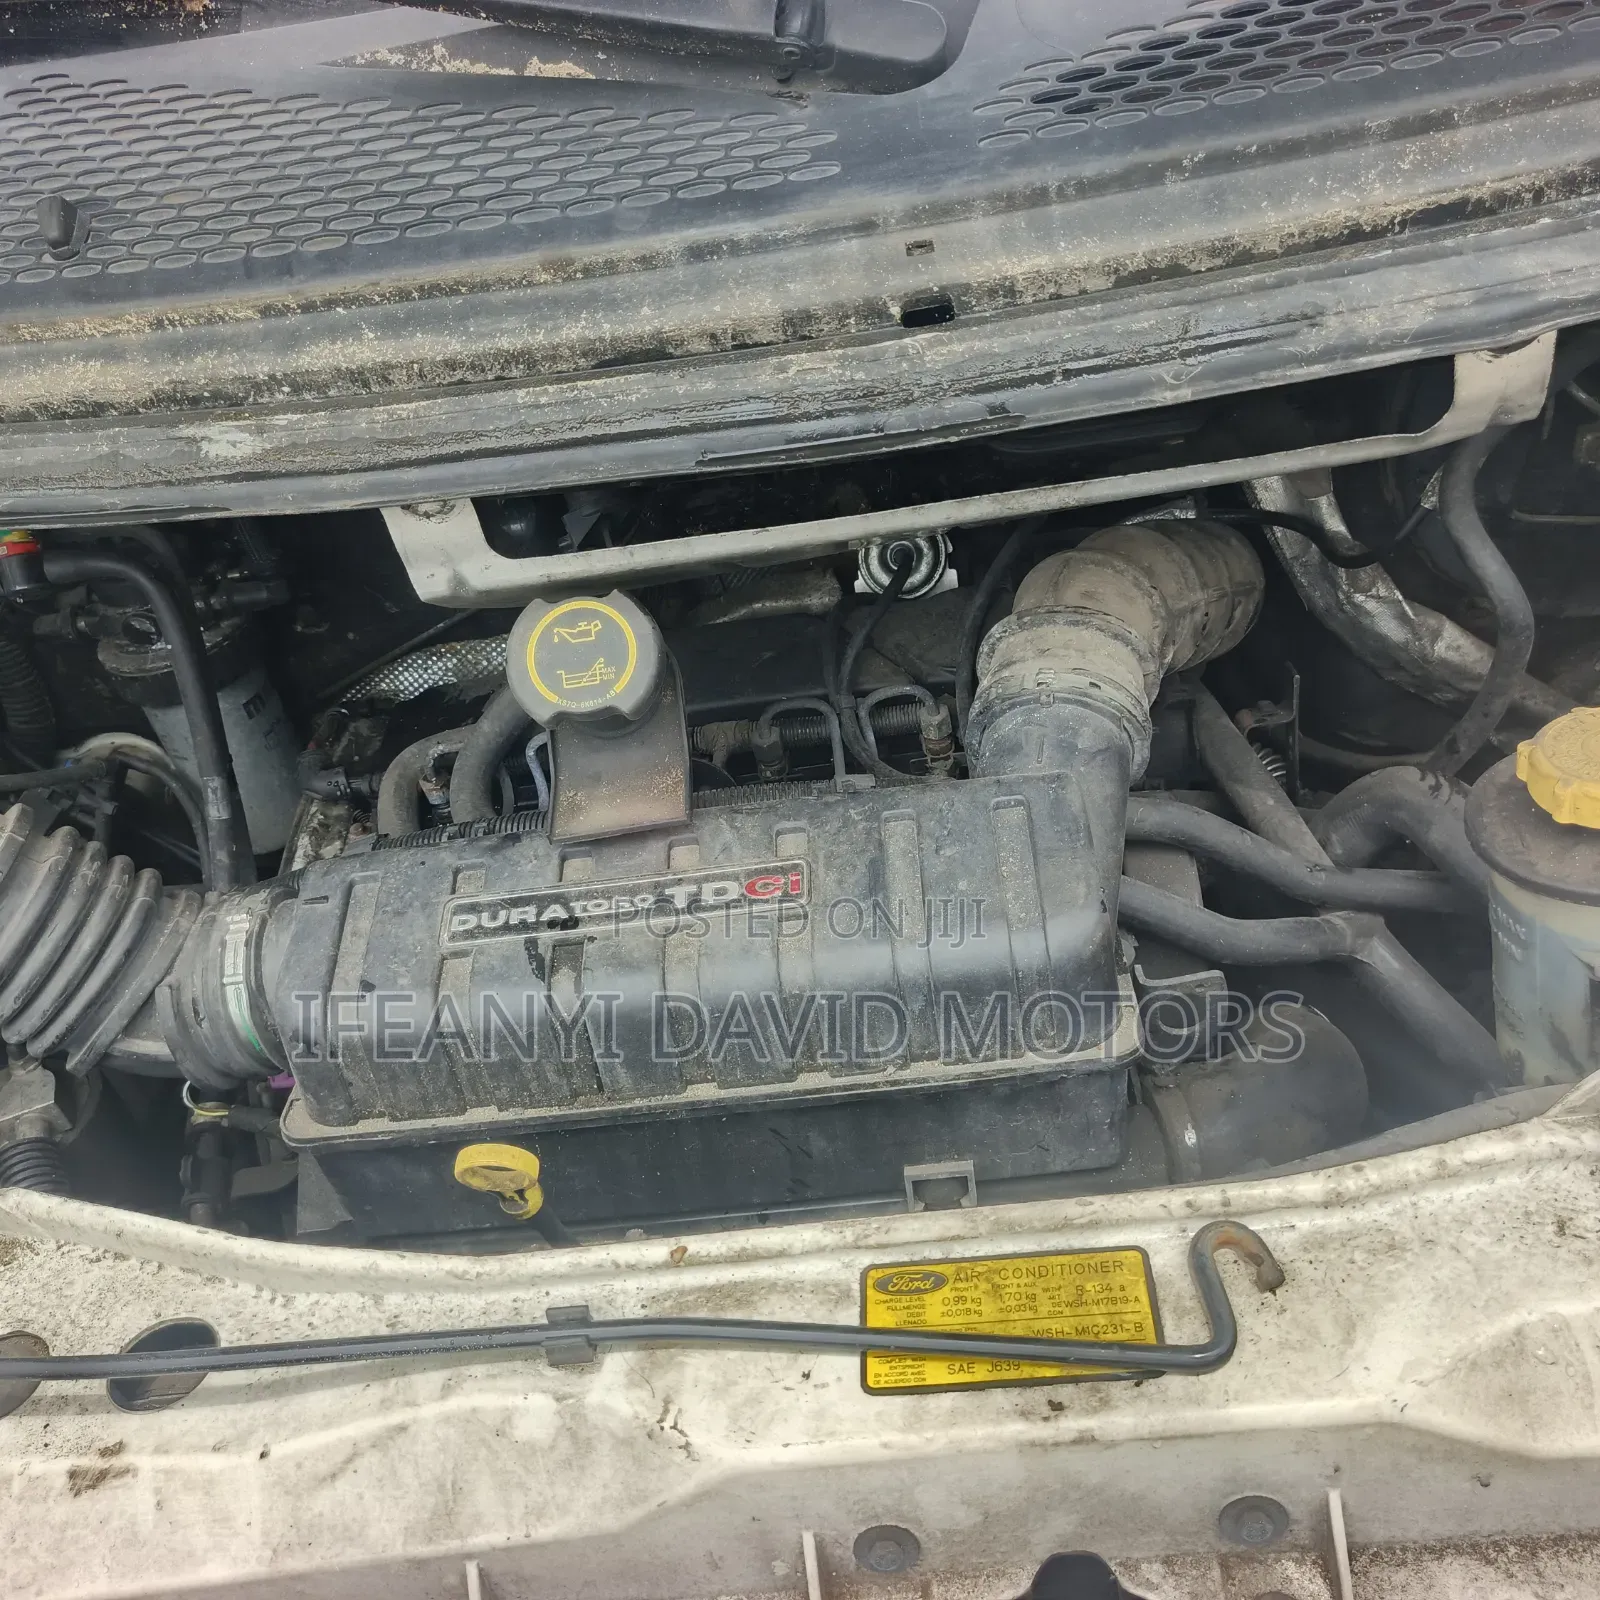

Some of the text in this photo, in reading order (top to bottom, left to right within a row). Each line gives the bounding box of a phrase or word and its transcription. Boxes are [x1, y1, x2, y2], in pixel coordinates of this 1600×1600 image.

[888, 1260, 1124, 1292] Ford AIR CONDITIONER
[1075, 1283, 1112, 1296] R-134
[875, 1297, 903, 1305] CHARGE
[942, 1296, 967, 1308] 0,99
[970, 1296, 982, 1307] kg
[1025, 1291, 1037, 1303] kg
[973, 1308, 983, 1317] kg
[1028, 1304, 1038, 1313] kg
[947, 1361, 976, 1375] SAE
[986, 1360, 1021, 1374] J639
